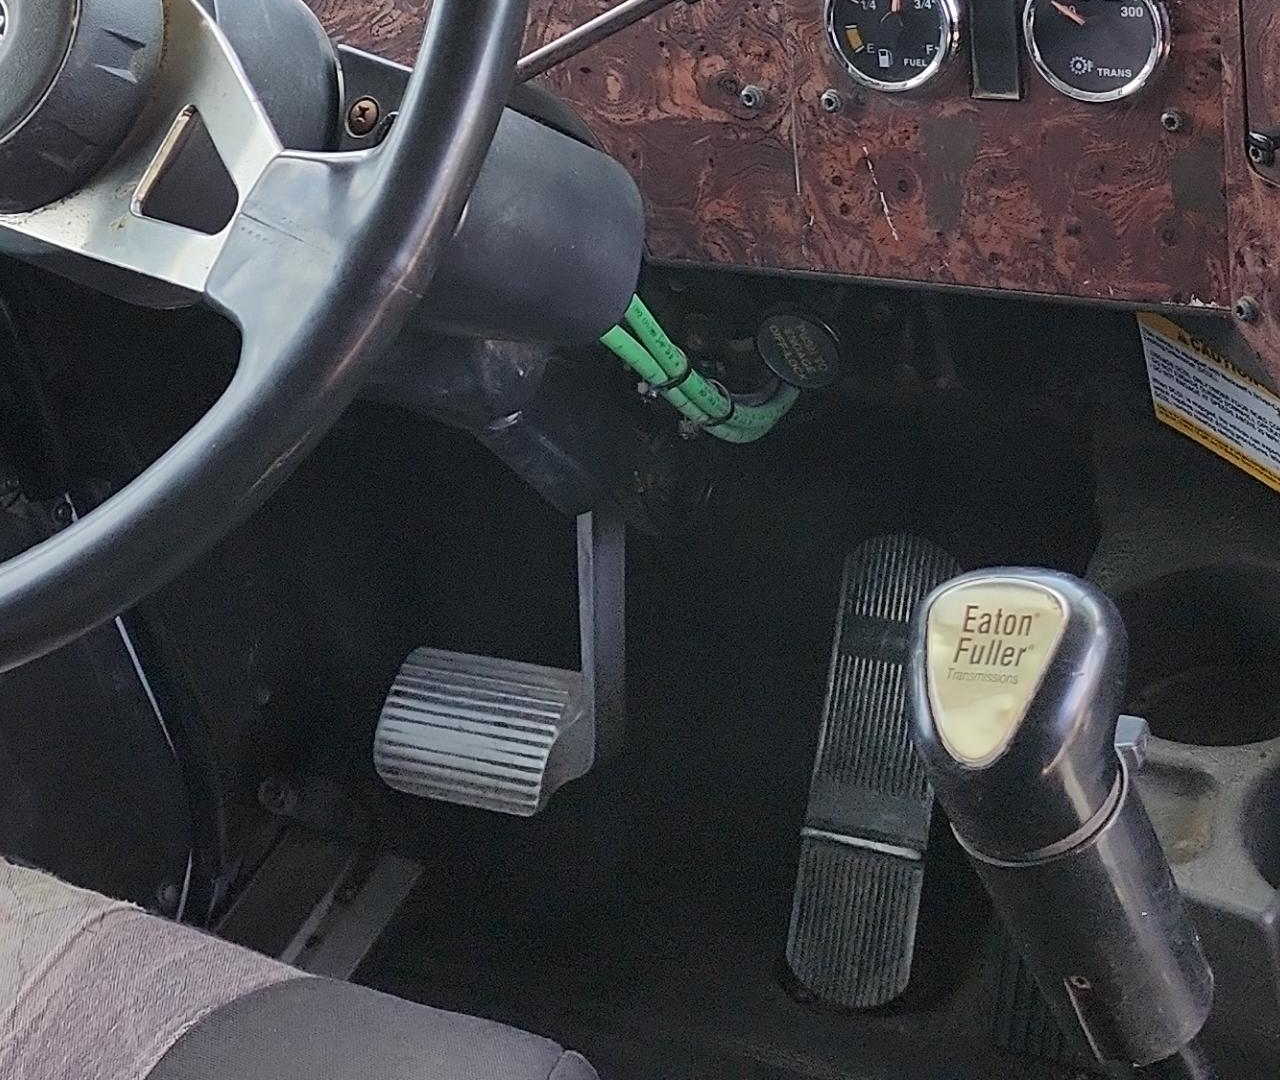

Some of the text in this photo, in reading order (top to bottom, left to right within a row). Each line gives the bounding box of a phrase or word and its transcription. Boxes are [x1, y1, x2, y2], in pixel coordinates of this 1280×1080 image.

[861, 0, 877, 10] 1/4
[913, 0, 932, 9] 3/4
[1121, 7, 1143, 17] 300
[867, 44, 875, 54] E
[925, 44, 933, 55] F
[904, 58, 927, 67] FUEL
[1097, 68, 1132, 78] TRANS
[962, 605, 1033, 637] Eaton
[953, 637, 1027, 668] Fuller
[946, 667, 1019, 686] Transmissions
